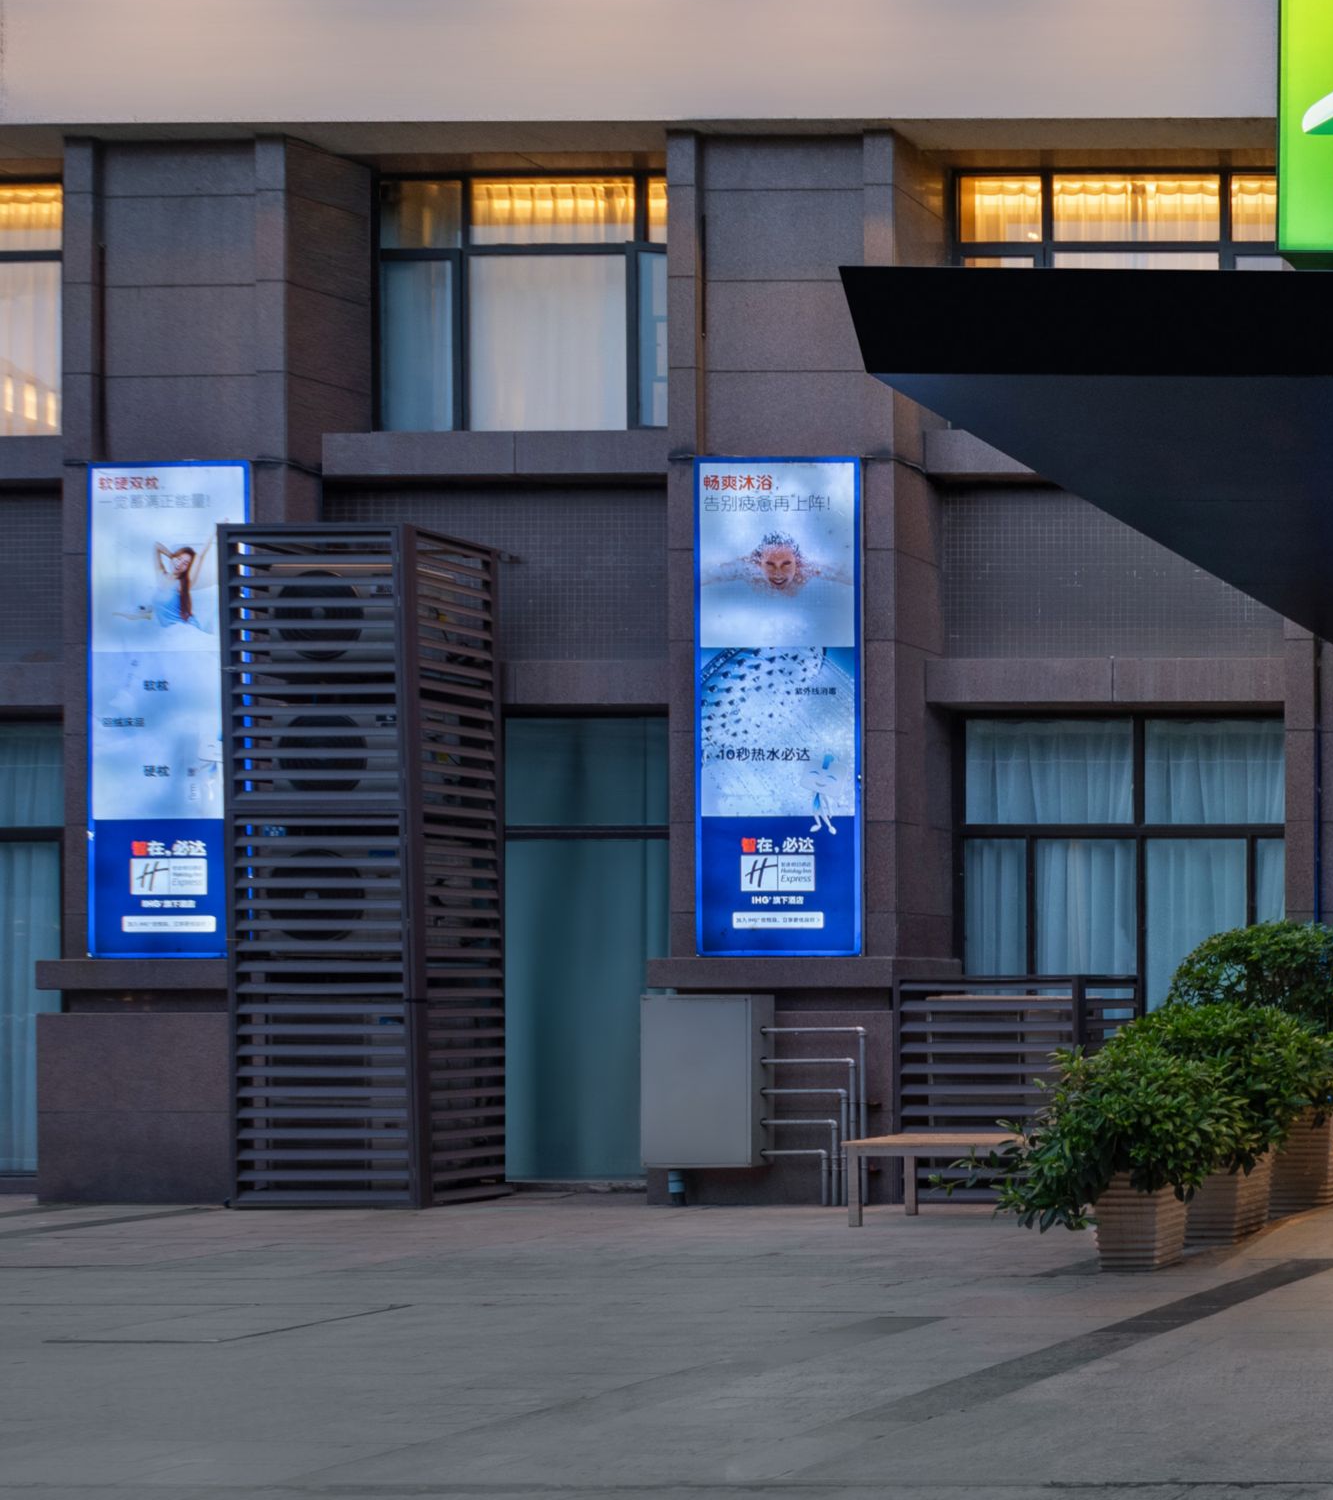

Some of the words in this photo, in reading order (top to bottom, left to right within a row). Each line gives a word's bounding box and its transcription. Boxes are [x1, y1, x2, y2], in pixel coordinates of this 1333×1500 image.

[719, 747, 810, 761] 10秒热水必达
